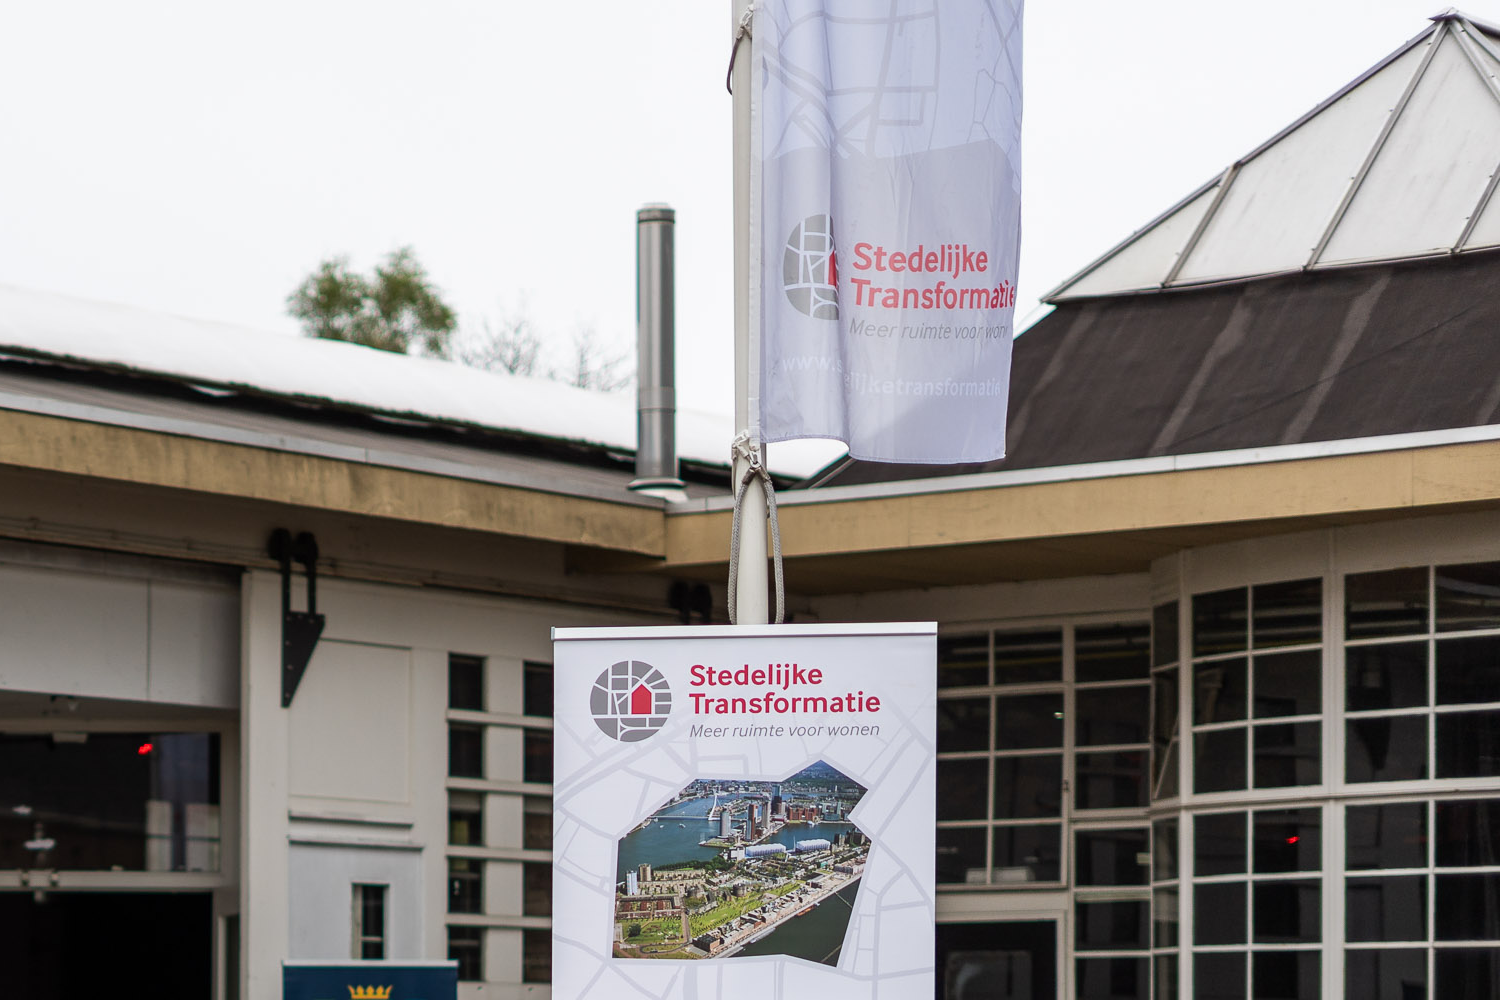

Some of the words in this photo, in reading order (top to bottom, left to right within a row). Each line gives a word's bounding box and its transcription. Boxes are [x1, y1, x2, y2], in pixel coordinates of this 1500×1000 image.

[852, 242, 988, 279] Stedelijke
[851, 277, 1014, 310] Transformatie
[850, 317, 898, 338] Meer
[901, 322, 951, 340] ruimte
[955, 325, 982, 340] voor
[689, 663, 823, 690] Stedelijke
[689, 691, 881, 715] Transformatie
[690, 724, 729, 738] Meer
[733, 724, 784, 738] ruimte
[789, 726, 823, 737] voor
[828, 725, 880, 737] wonen
